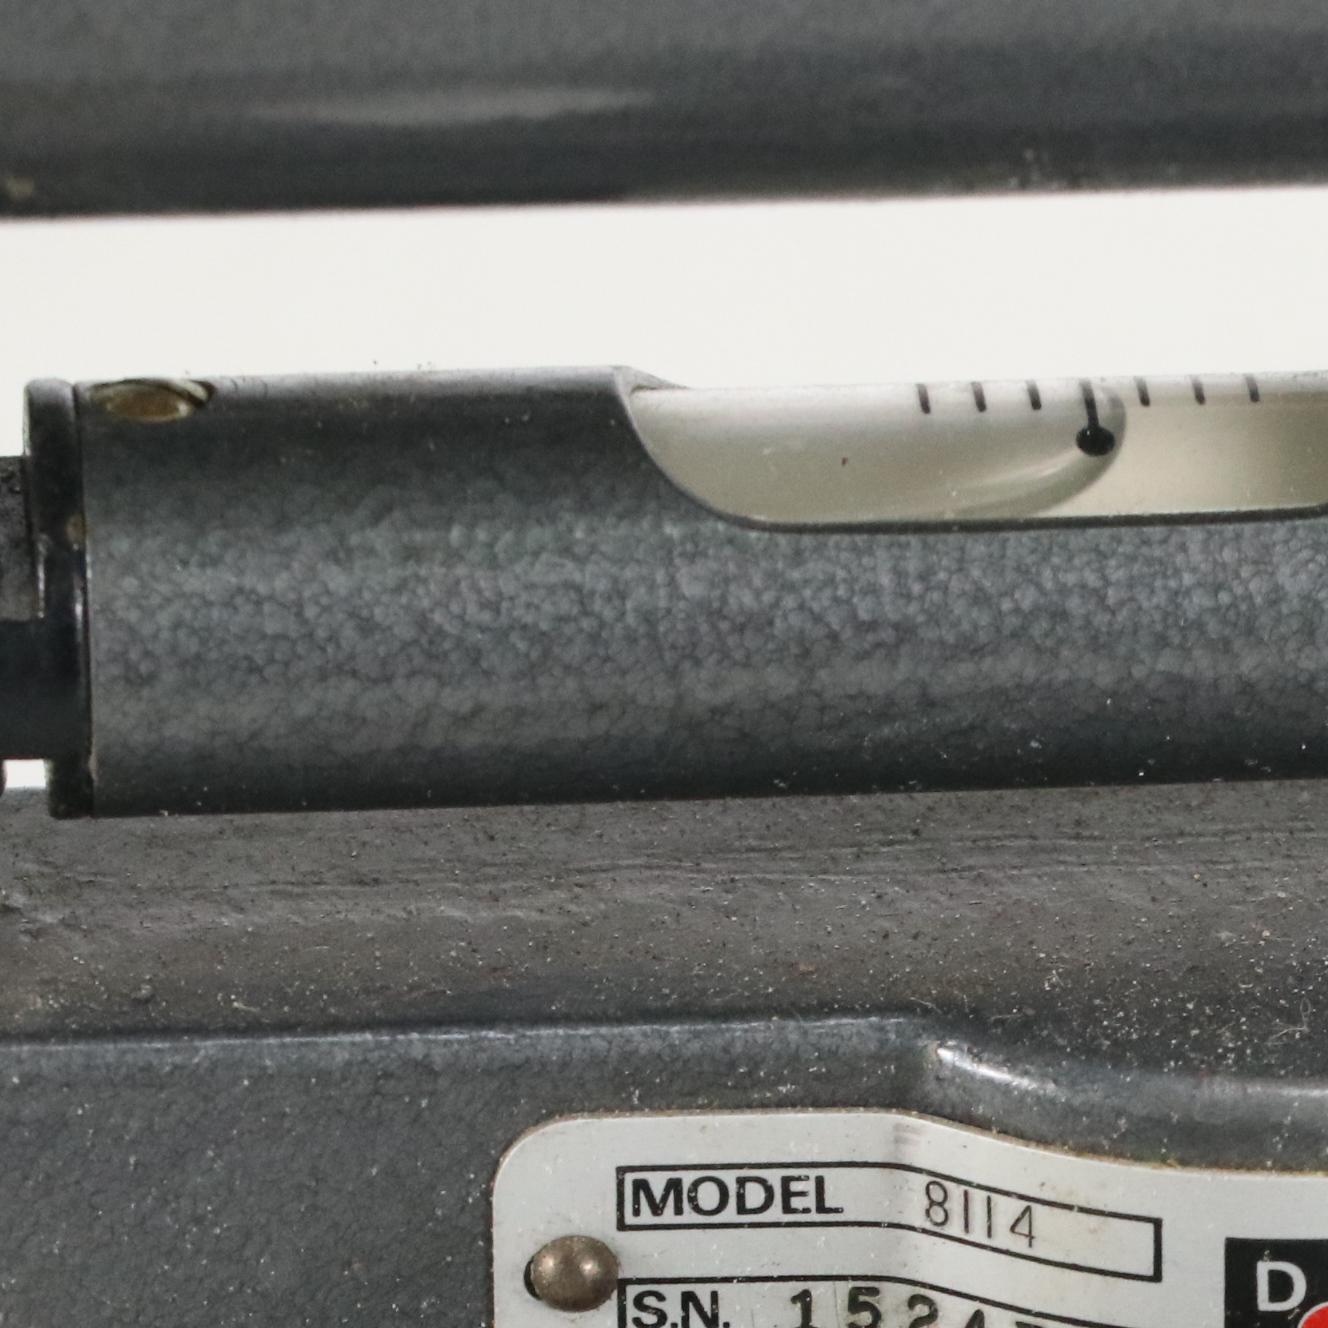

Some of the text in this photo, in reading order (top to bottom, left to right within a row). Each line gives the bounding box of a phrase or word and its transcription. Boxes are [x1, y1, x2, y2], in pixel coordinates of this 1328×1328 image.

[630, 1174, 1037, 1249] MODEL 8114
[1254, 1259, 1308, 1313] D
